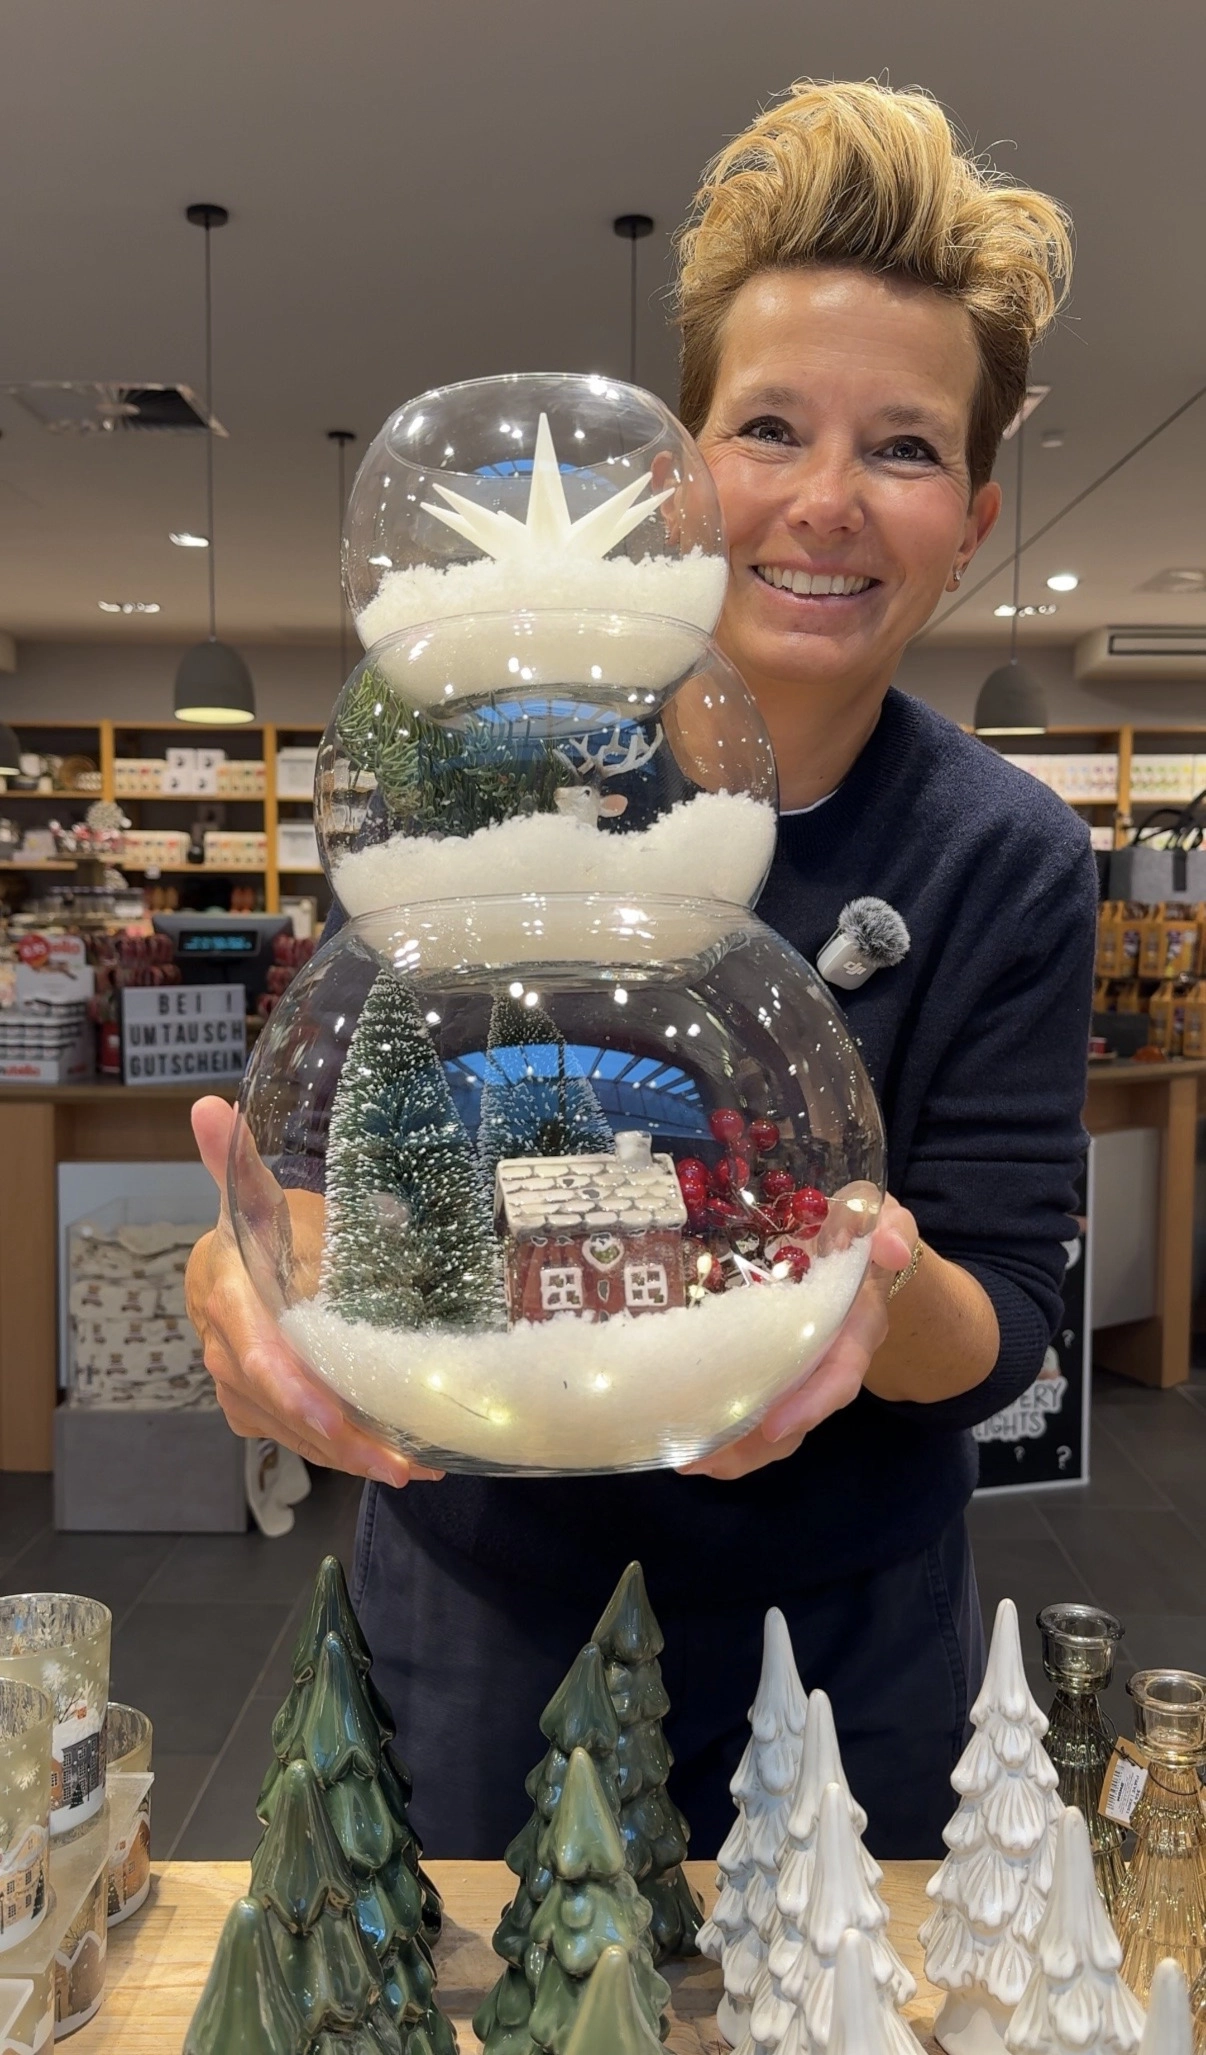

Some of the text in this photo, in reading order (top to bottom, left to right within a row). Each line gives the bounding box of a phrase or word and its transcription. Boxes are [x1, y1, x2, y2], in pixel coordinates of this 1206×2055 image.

[159, 991, 201, 1016] BEI
[129, 1021, 243, 1047] UMTAUSCH
[129, 1050, 243, 1078] GUTSCHEIN
